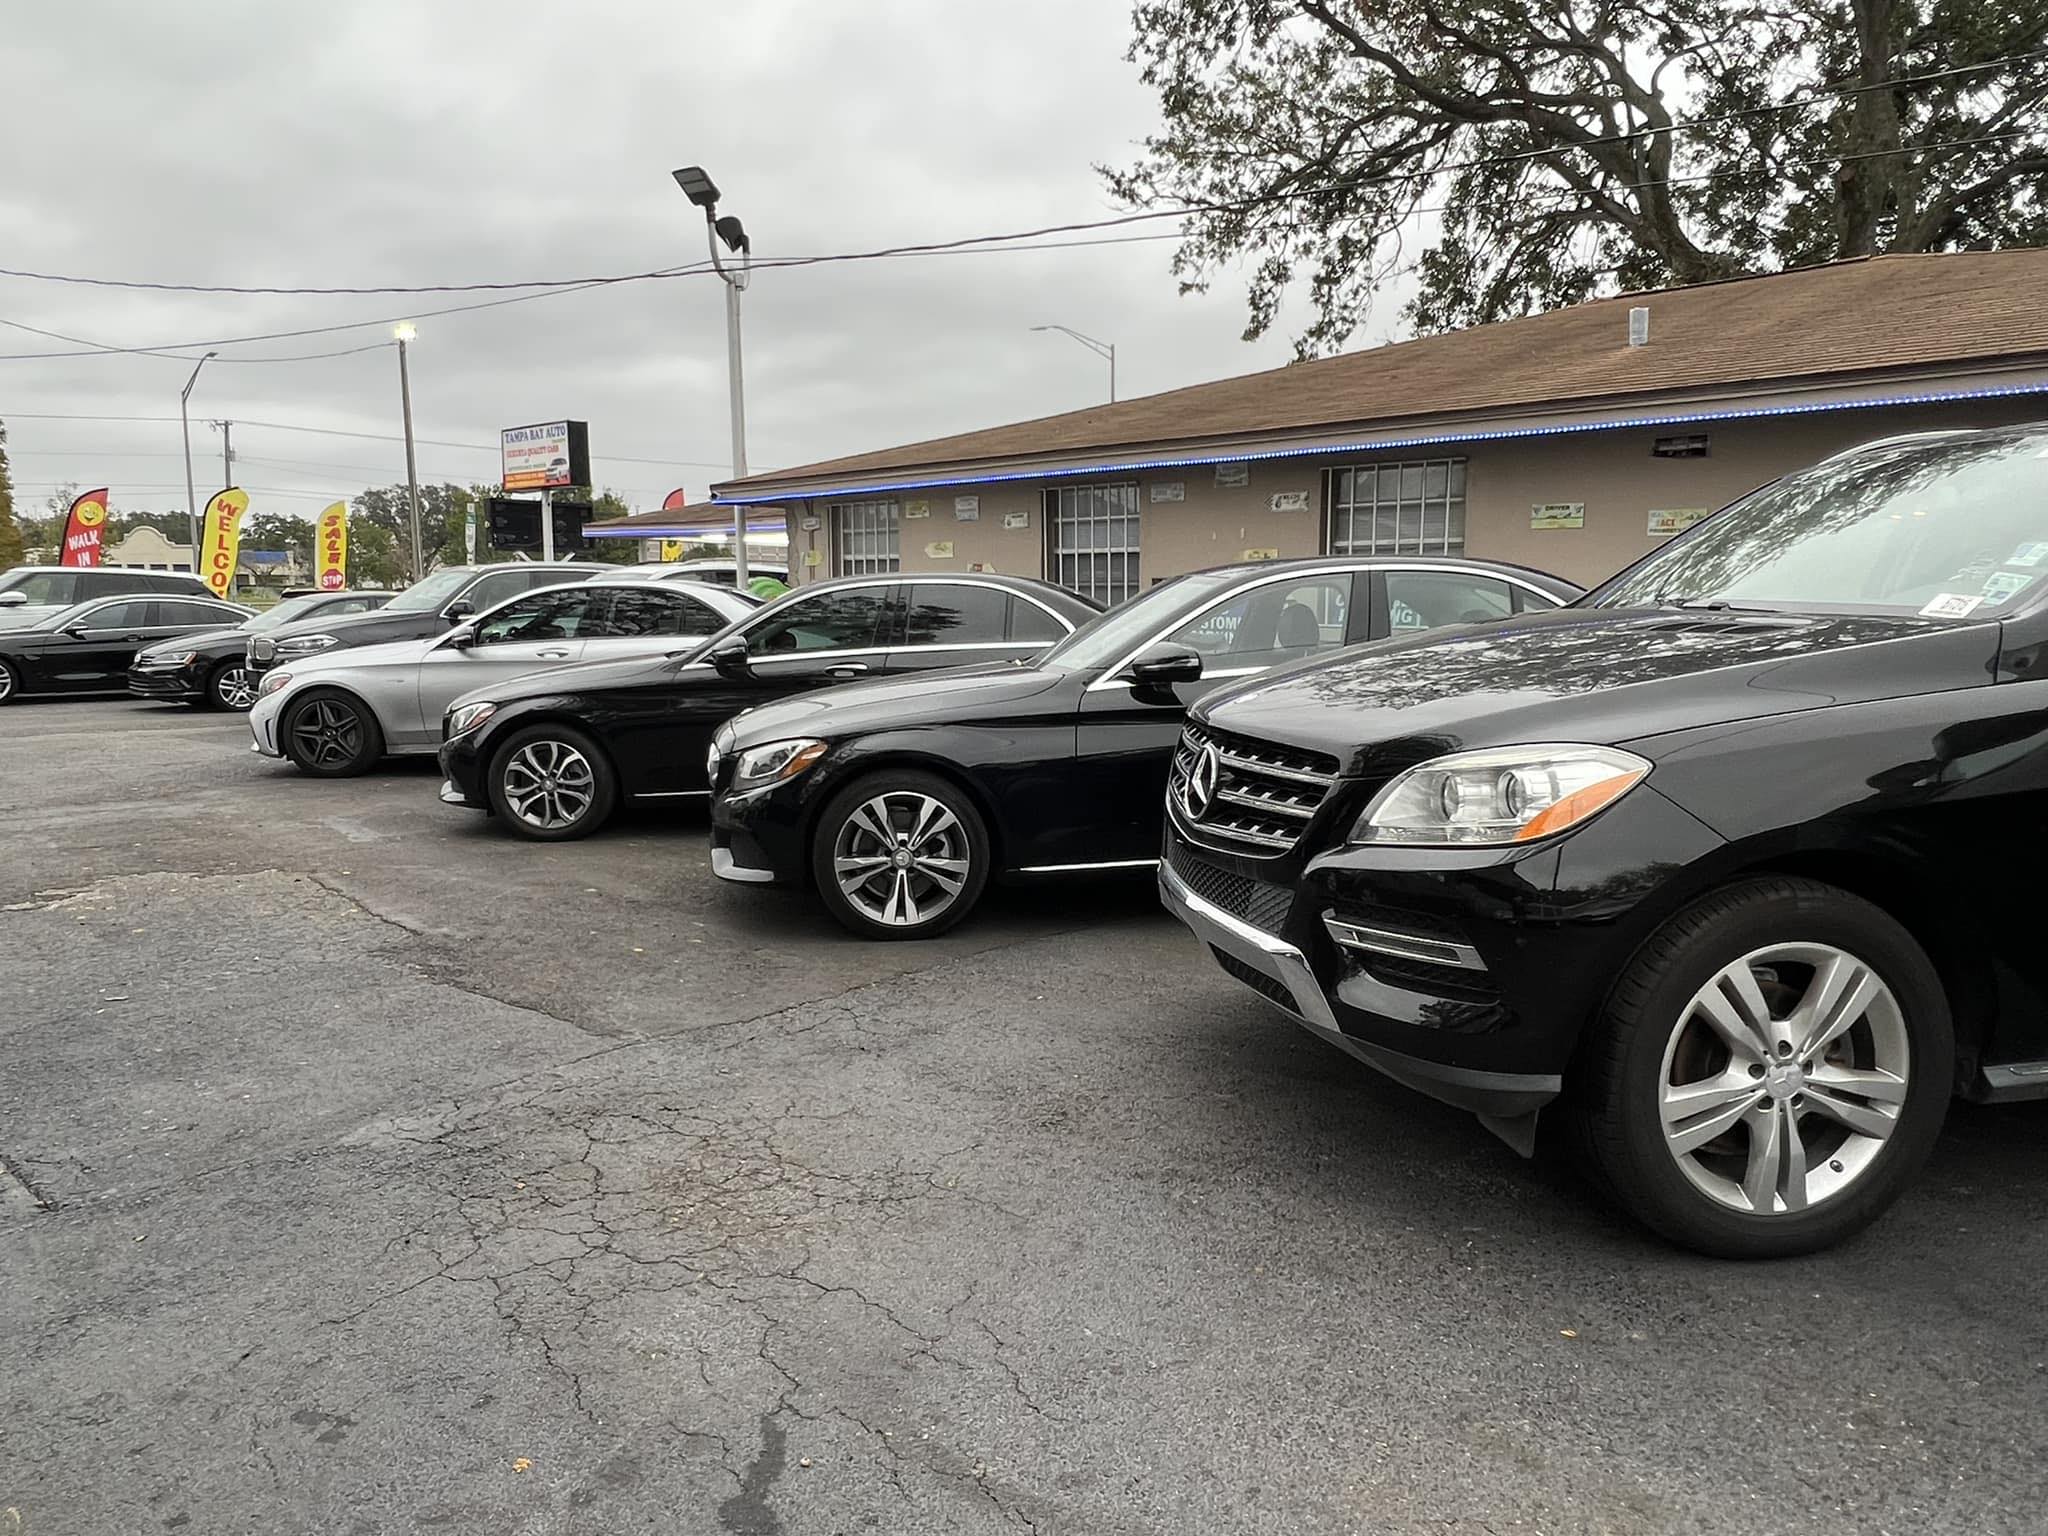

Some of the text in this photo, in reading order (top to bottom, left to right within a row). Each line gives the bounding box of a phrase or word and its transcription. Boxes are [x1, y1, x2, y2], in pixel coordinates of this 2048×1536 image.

[505, 424, 566, 444] TAMPA BAY AUTO
[68, 529, 100, 550] WALK
[211, 498, 239, 598] WELCO
[324, 515, 341, 564] SALE
[77, 551, 91, 568] IN
